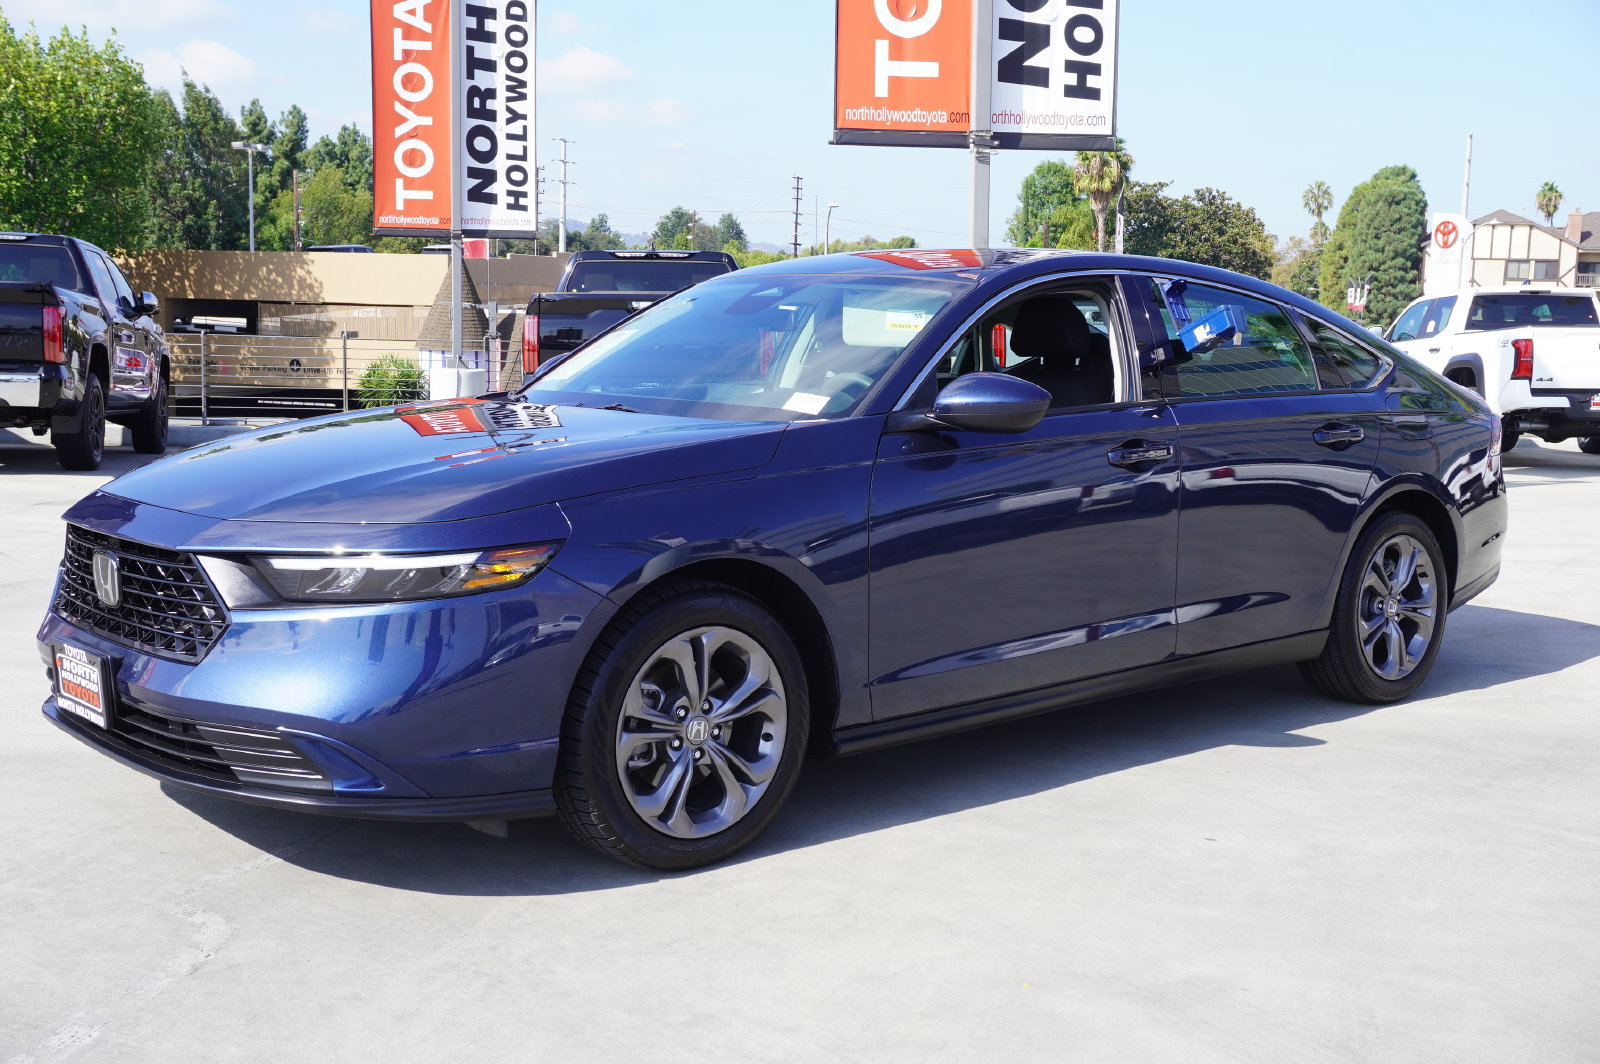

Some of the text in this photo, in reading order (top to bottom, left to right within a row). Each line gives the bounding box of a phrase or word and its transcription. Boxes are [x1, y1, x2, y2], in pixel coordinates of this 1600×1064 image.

[997, 0, 1051, 88] N
[392, 0, 434, 210] TOYOTA
[465, 3, 498, 205] NORTH
[504, 0, 529, 212] HOLLYWOOD
[845, 106, 970, 126] northhollywoodtoyota.com
[991, 109, 1106, 129] orthhollywoodtoyota.com
[63, 644, 88, 663] TOYOTA
[61, 670, 99, 693] HOLLYWOOD
[62, 658, 98, 683] NORTH
[62, 680, 100, 707] TOYOTA
[57, 697, 105, 727] NORTH HOLLYWOOD
